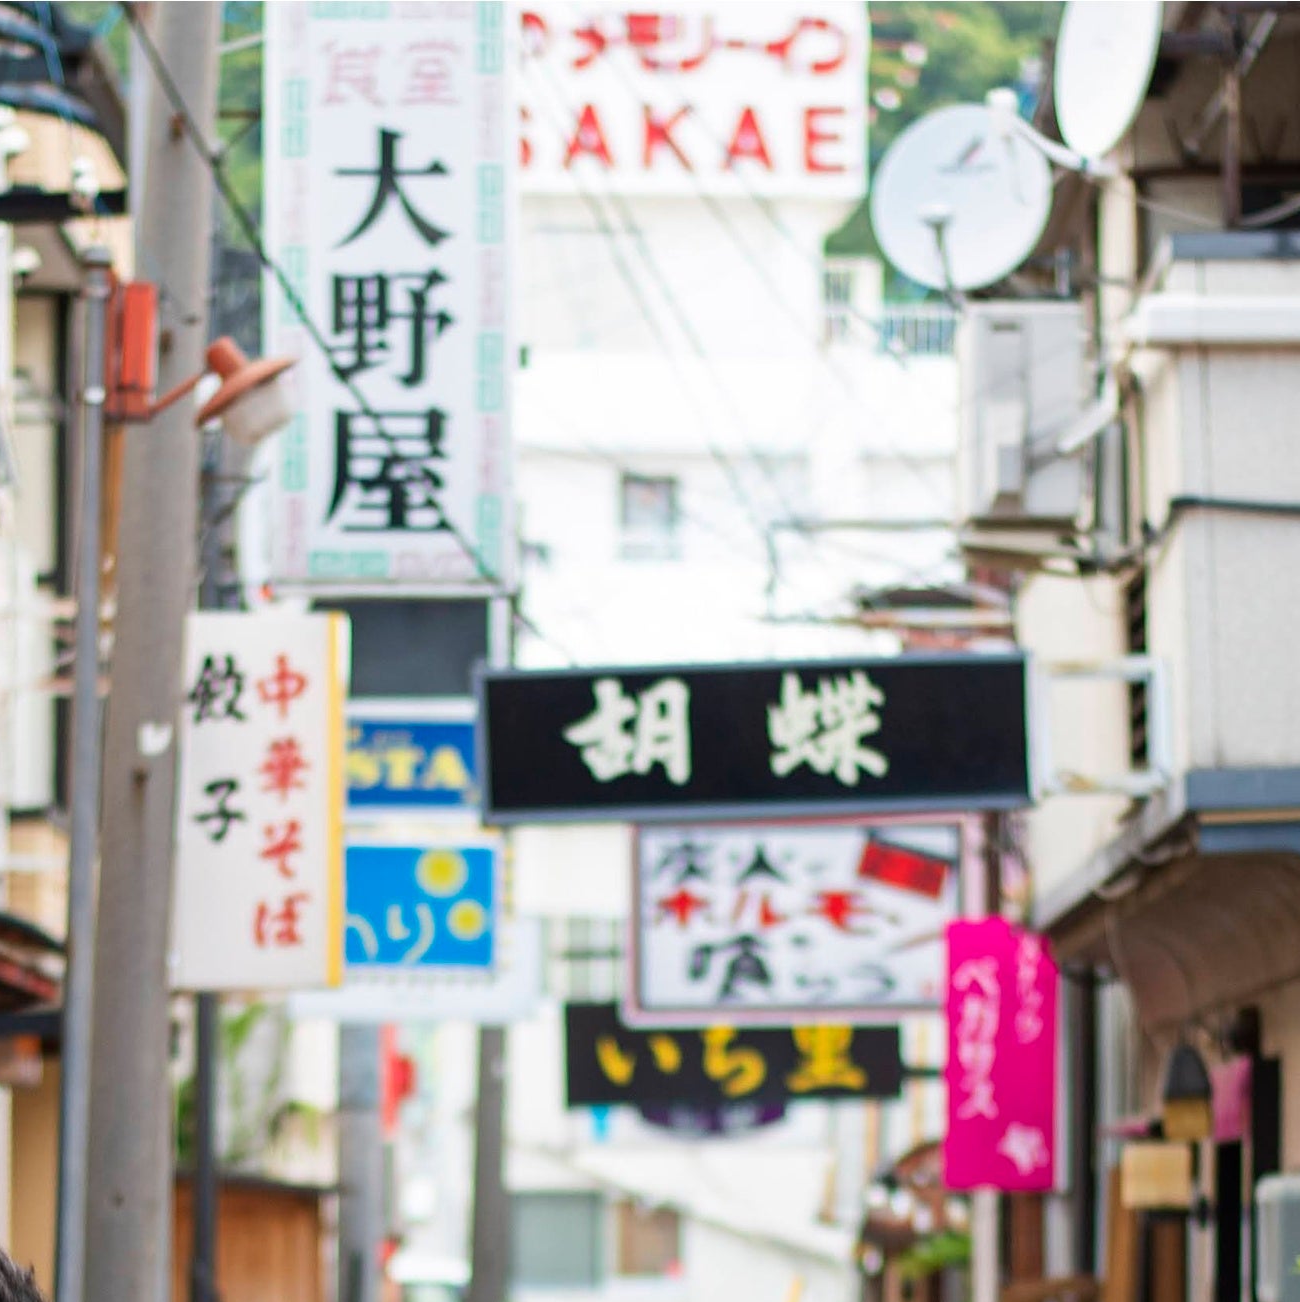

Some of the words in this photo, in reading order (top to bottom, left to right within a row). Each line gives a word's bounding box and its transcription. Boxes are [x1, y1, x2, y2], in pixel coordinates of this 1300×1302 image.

[323, 127, 454, 534] 大野屋
[188, 654, 245, 843] 餃子
[254, 653, 312, 948] 中華そば
[563, 669, 890, 787] 胡蝶
